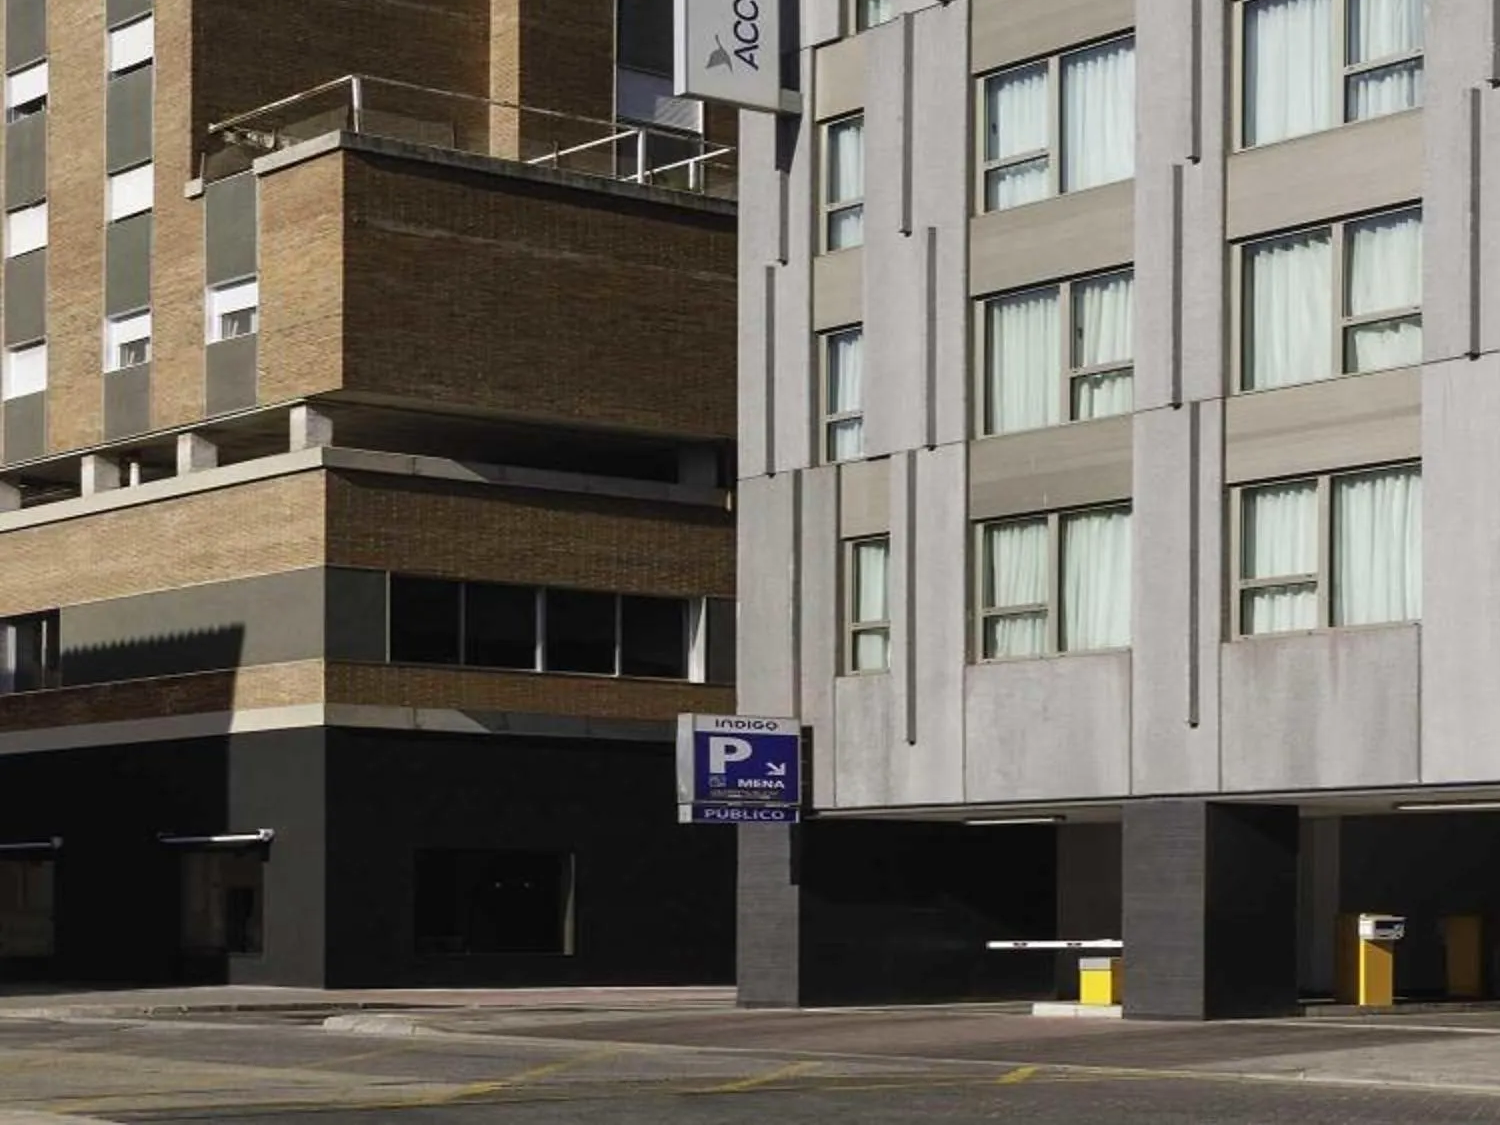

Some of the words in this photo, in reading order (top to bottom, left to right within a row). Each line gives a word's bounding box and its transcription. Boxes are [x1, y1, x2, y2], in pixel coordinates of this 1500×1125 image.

[715, 719, 778, 731] INDIGO
[709, 736, 752, 774] P
[738, 779, 784, 789] MENA
